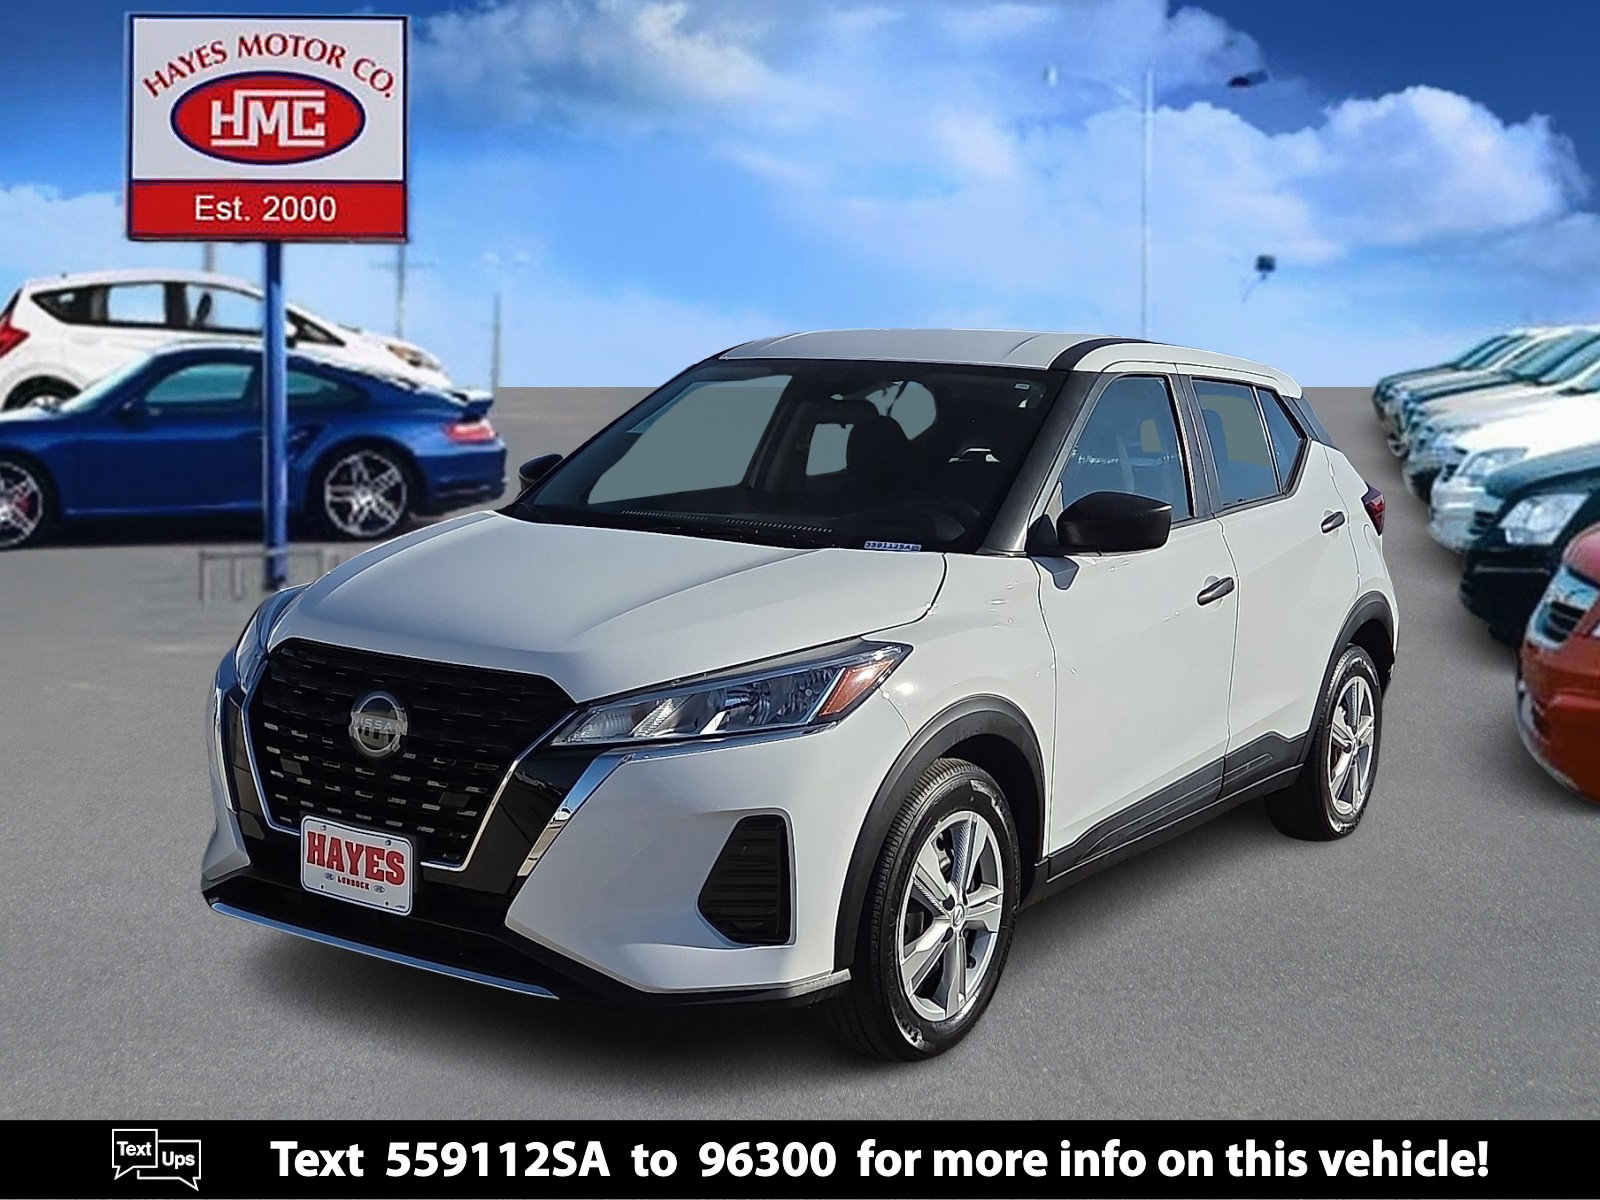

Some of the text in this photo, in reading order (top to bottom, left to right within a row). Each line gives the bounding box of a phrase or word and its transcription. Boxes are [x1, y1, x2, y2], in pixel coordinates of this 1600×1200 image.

[142, 33, 394, 98] HAYES MOTOR CO.
[210, 89, 326, 147] HMC
[195, 195, 337, 222] Est. 2000
[352, 713, 407, 735] NISSAN
[306, 830, 405, 886] HAYES
